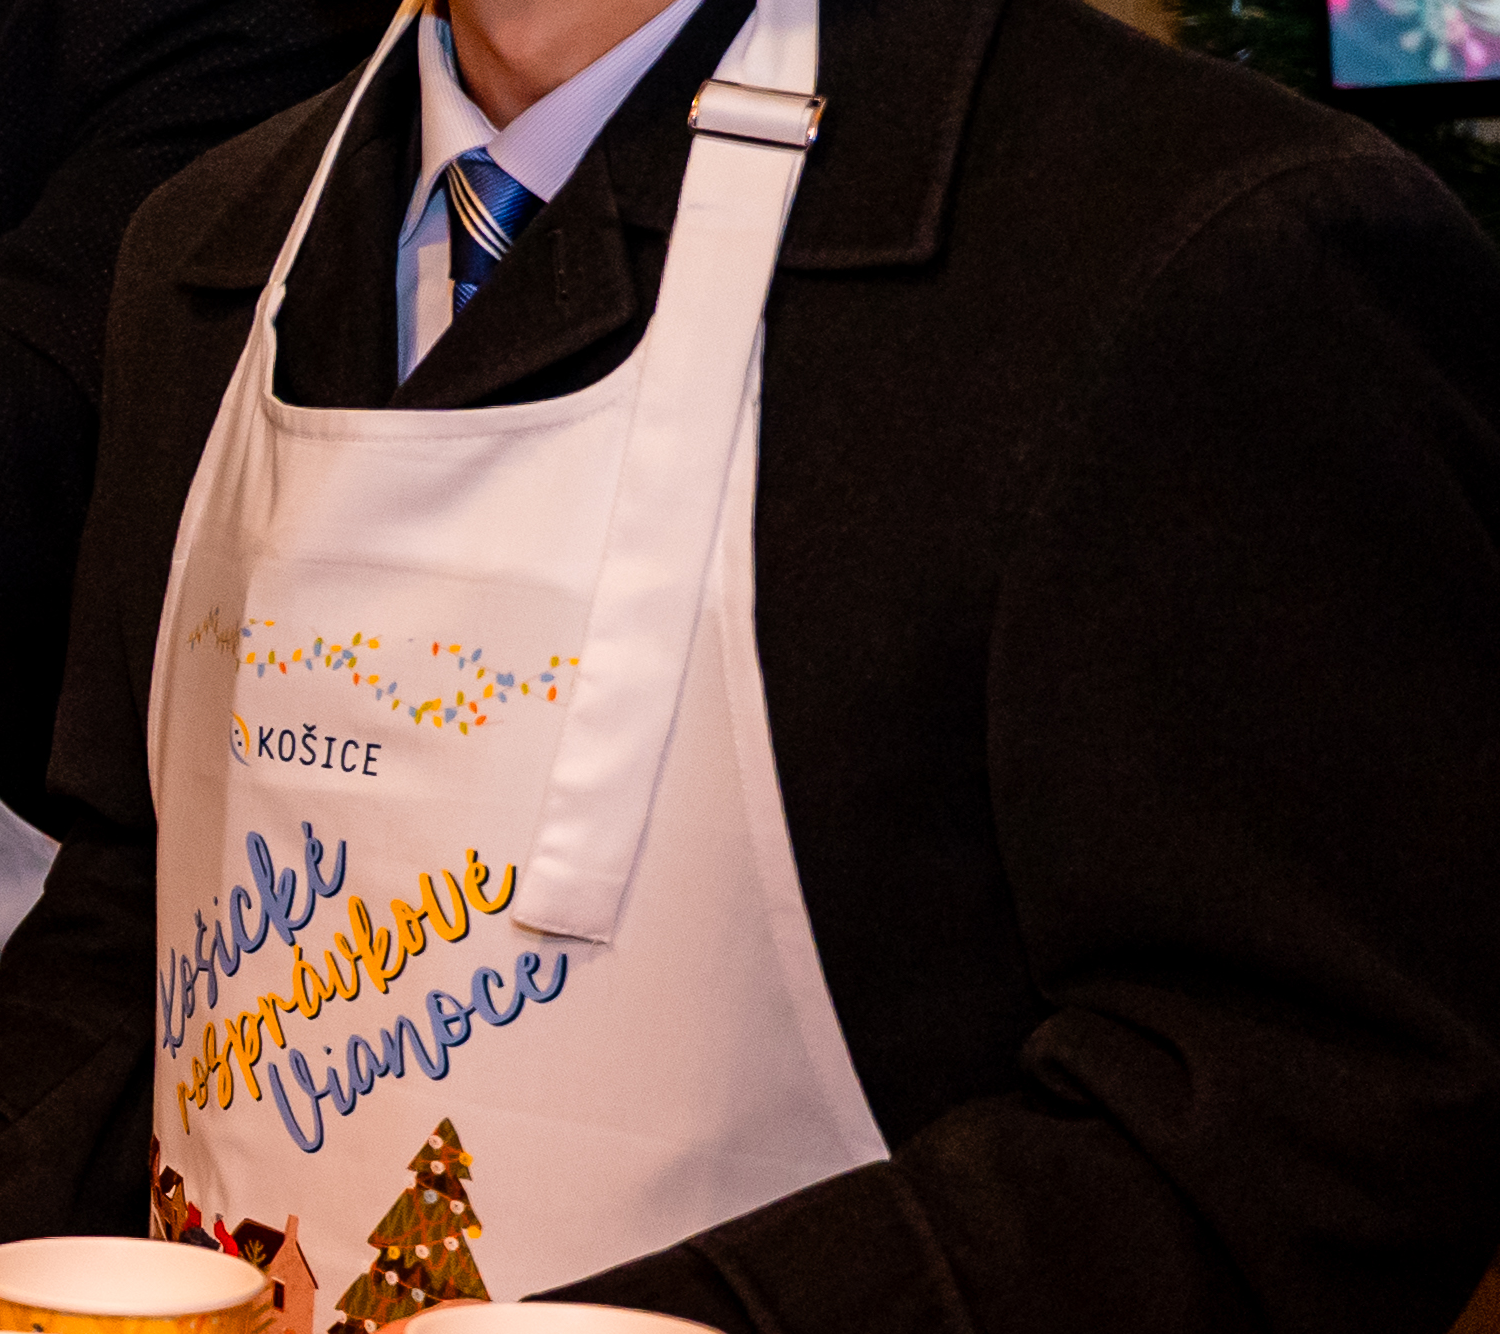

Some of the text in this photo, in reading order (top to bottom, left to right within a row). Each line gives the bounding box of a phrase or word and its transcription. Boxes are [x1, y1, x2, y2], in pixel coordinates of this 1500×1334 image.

[257, 724, 382, 777] KOŠICE
[159, 820, 347, 1059] Košické
[267, 951, 568, 1154] Vianoce
